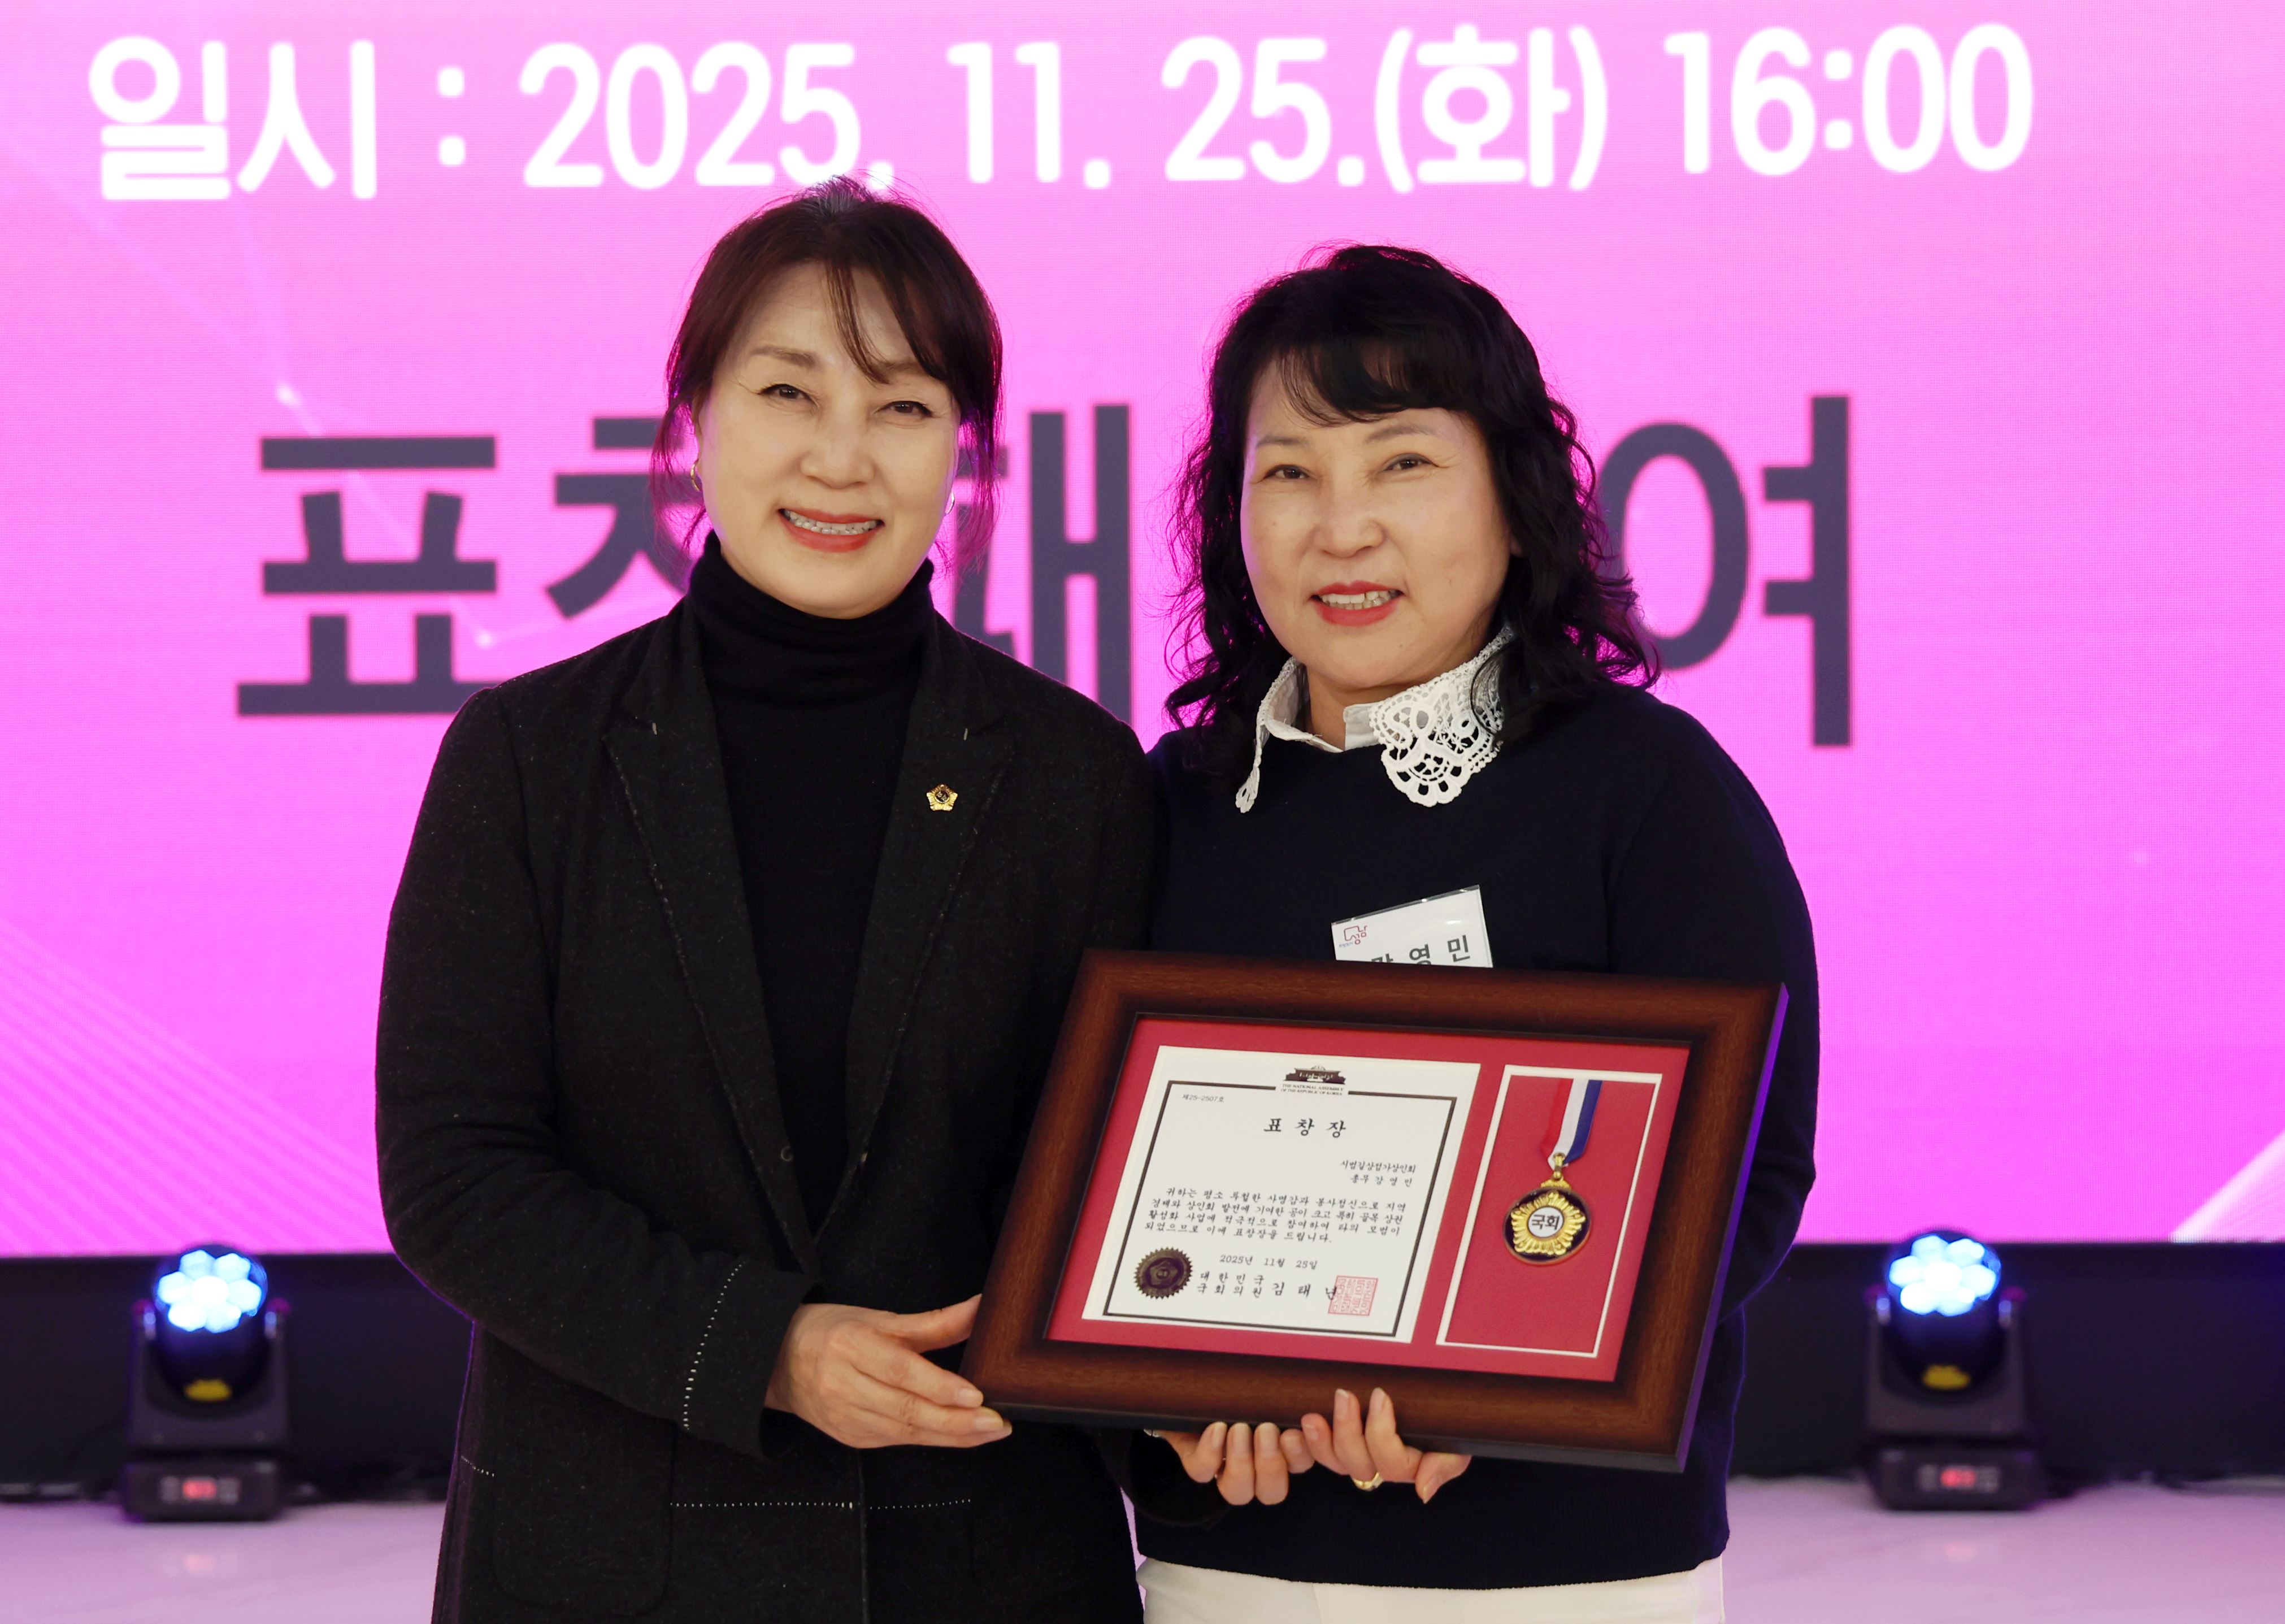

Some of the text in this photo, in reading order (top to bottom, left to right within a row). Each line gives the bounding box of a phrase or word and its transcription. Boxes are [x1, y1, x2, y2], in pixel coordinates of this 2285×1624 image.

[89, 36, 377, 201] 일시
[518, 40, 894, 190] 2025.
[946, 40, 1112, 190] 11.
[1160, 23, 1608, 194] 25.(화)
[1663, 21, 2035, 177] 16:00
[1152, 1198, 1180, 1209] 경제와
[1187, 1201, 1215, 1211] 상인회
[1222, 1203, 1249, 1213] 발전에
[1256, 1205, 1283, 1217] 기여한
[1288, 1207, 1306, 1217] 공이
[1336, 1210, 1354, 1220] 특히
[1359, 1212, 1379, 1222] 골목
[1384, 1214, 1403, 1224] 상권
[1166, 1187, 1197, 1198] 귀하는
[1204, 1189, 1223, 1199] 평소
[1267, 1193, 1309, 1206] 사명감과
[1316, 1197, 1379, 1210] 봉사정신으로
[1387, 1202, 1406, 1213] 지역
[1145, 1222, 1332, 1243] 되었으므로 이에 표창장을 드립니다.
[1148, 1209, 1400, 1236] 활성화 사업에 적극적으로 참여하여 타의 모범이
[1531, 1214, 1559, 1230] 국회
[1220, 1254, 1317, 1270] 2025년 11월 25일
